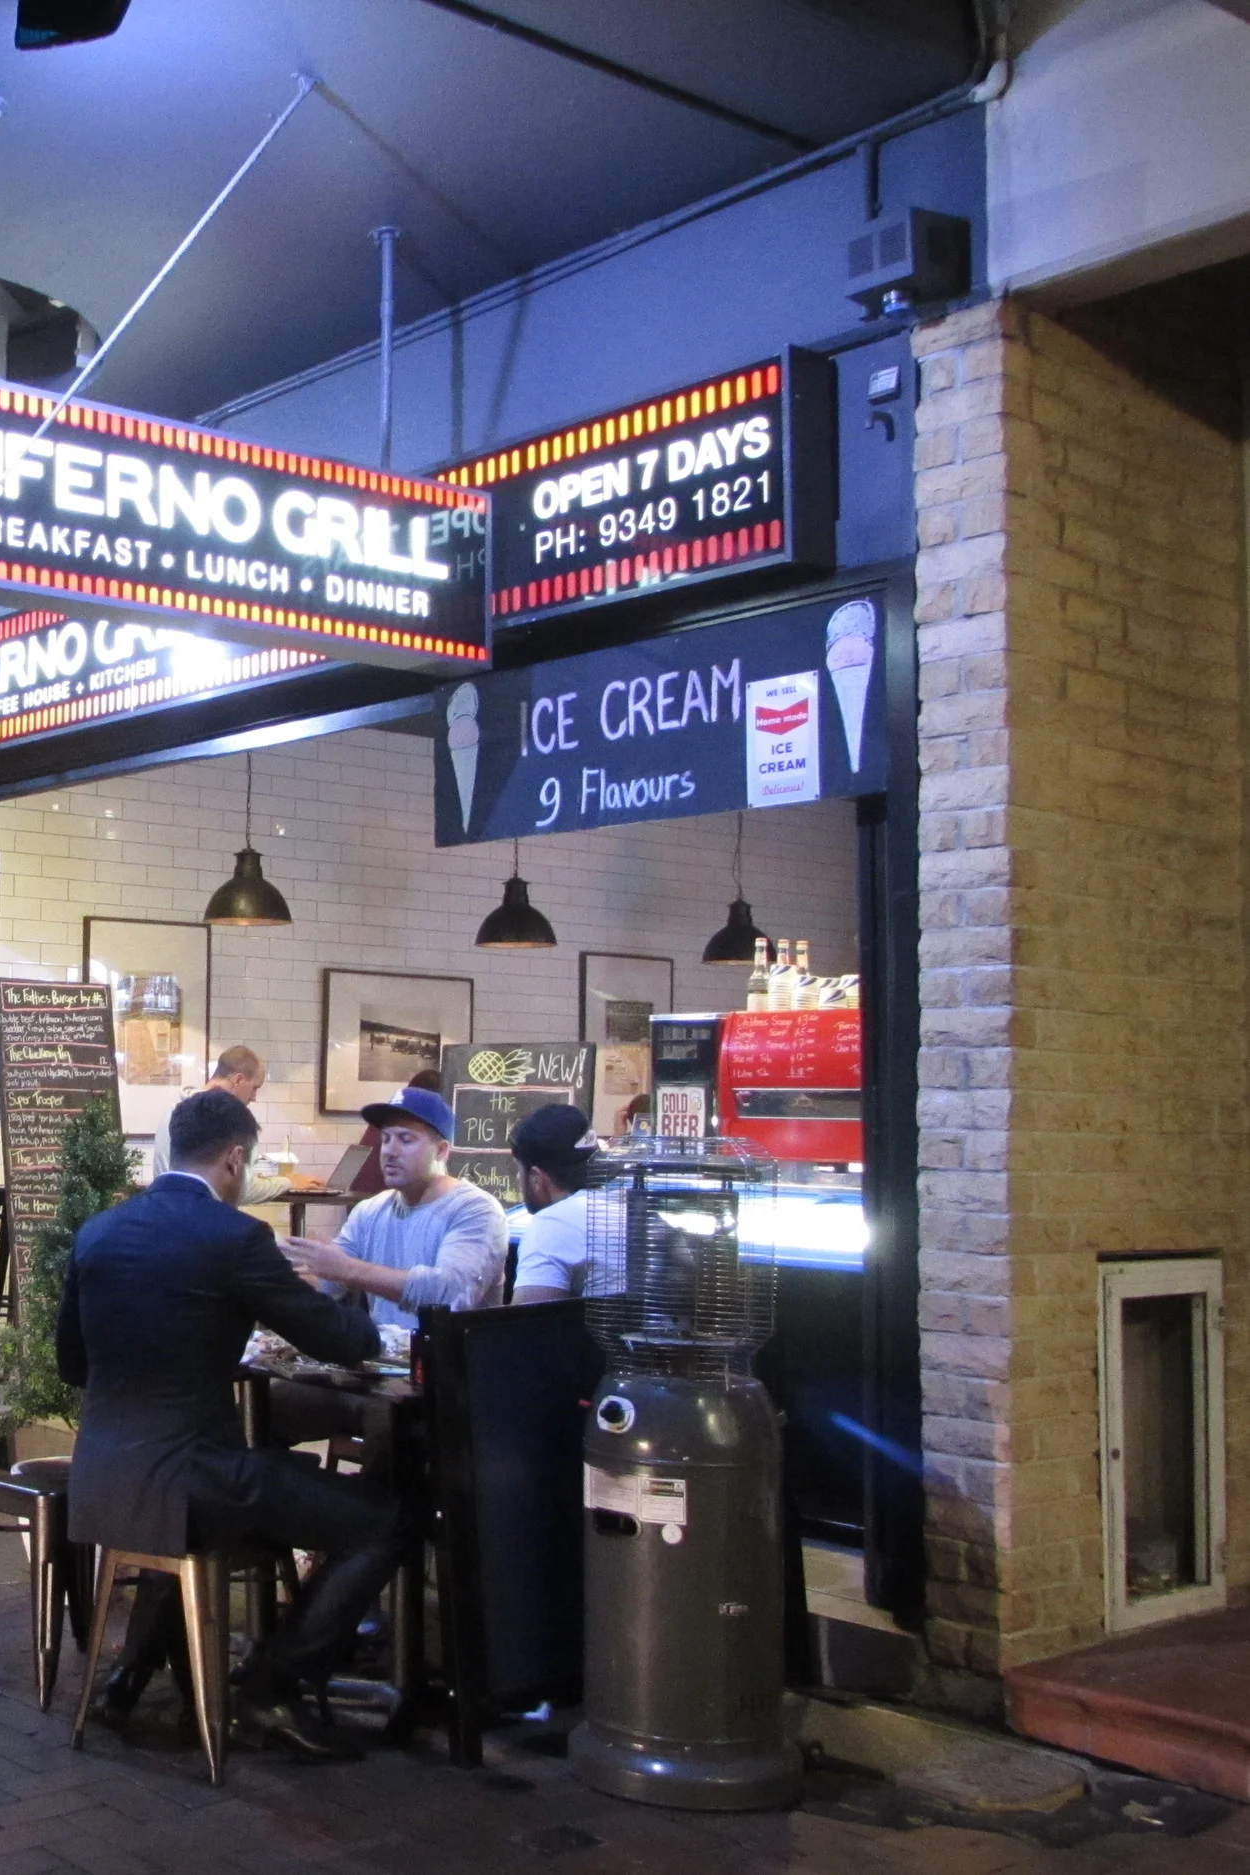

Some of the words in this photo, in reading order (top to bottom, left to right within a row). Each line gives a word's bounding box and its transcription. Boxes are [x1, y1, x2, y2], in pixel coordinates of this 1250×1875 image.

[533, 457, 630, 520] OPEN
[636, 449, 659, 491] 7
[667, 416, 771, 483] DAYS
[535, 524, 586, 564] PH:
[599, 497, 677, 547] 9349
[693, 470, 770, 521] 1821
[272, 489, 449, 580] GRILL
[187, 549, 289, 594] LUNCH
[326, 574, 430, 617] DINNER
[23, 681, 70, 709] HOUSE
[90, 657, 157, 692] KITCHEN
[766, 688, 778, 698] WE
[782, 686, 798, 696] SELL
[521, 691, 579, 757] ICE
[600, 657, 742, 742] CREAM
[756, 716, 782, 728] Home
[783, 711, 808, 723] made
[771, 742, 794, 756] ICE
[758, 758, 807, 775] CREAM
[535, 777, 561, 827] 9
[581, 768, 696, 815] Flavours
[761, 781, 805, 796] Delicious!
[5, 987, 21, 1004] The
[51, 989, 78, 1009] Burger
[5, 1044, 23, 1061] The
[537, 1047, 588, 1089] NEW!
[9, 1092, 31, 1108] Super
[32, 1090, 66, 1107] Trooper
[661, 1092, 688, 1114] COLD
[464, 1117, 495, 1142] PIG
[12, 1150, 33, 1164] The
[13, 1196, 30, 1212] The
